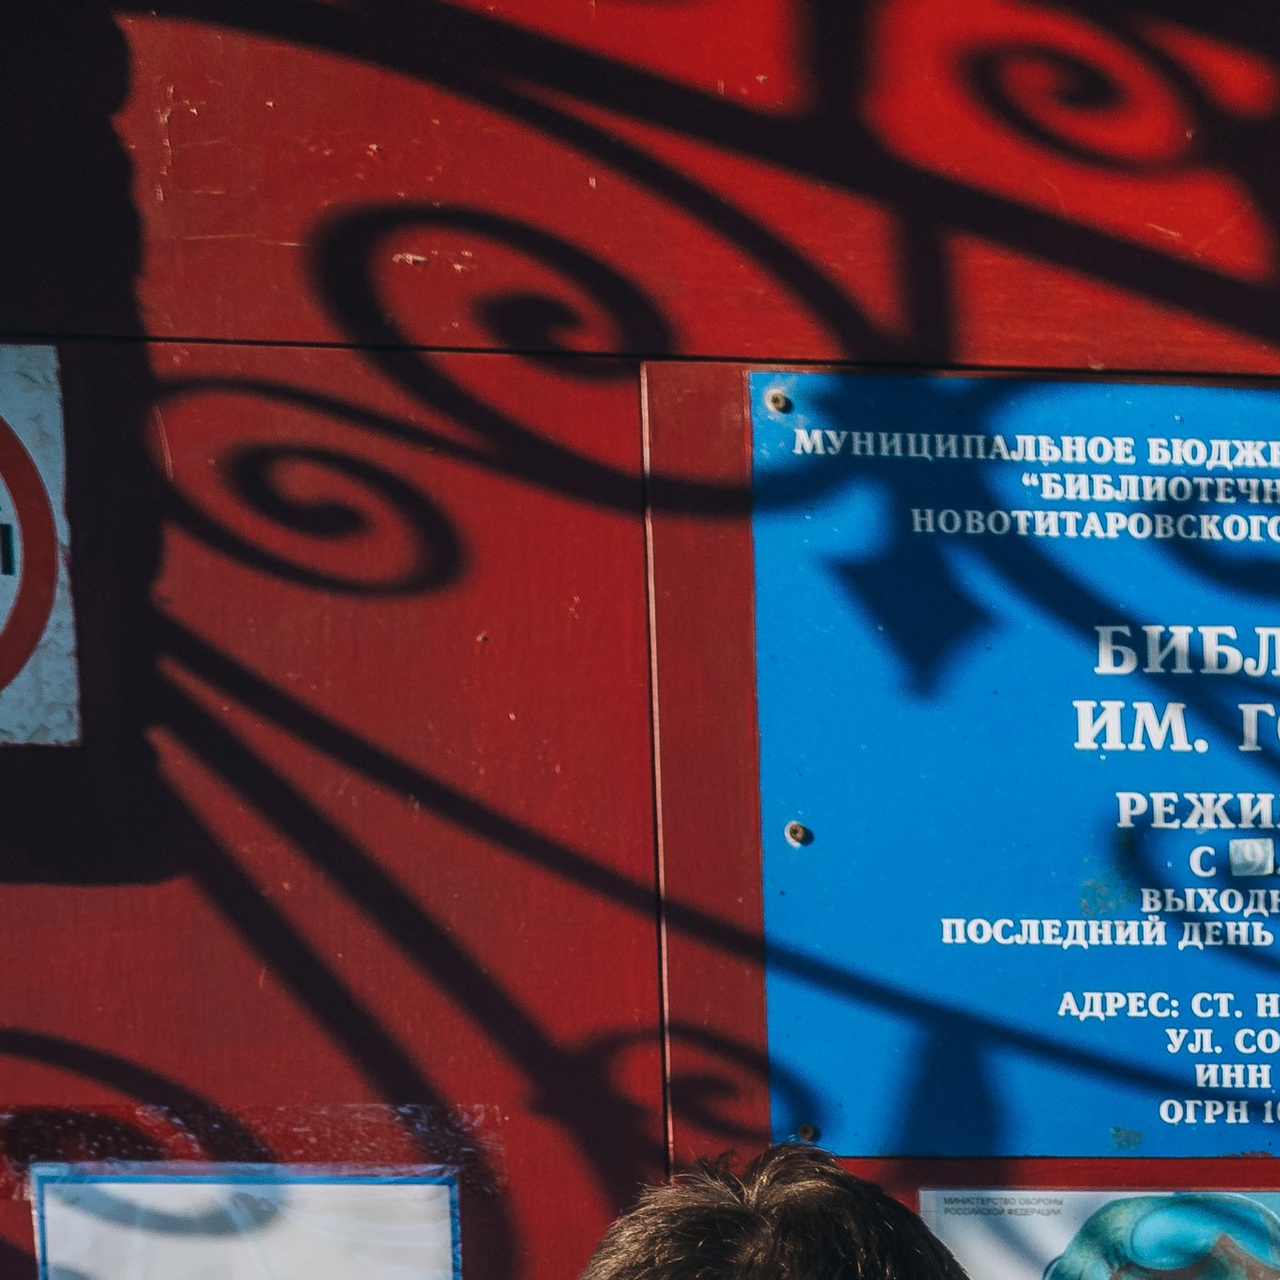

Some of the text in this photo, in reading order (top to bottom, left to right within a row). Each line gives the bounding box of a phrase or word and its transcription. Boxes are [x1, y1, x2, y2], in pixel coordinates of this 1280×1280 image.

[793, 429, 1135, 464] МУНИЦИПАЛЬНОЕ
[1073, 700, 1209, 755] ИМ.
[1189, 845, 1217, 877] С
[940, 915, 1168, 949] ПОСЛЕДНИЙ
[1178, 920, 1275, 949] ДЕНЬ
[1058, 991, 1180, 1021] АДРЕС:
[1191, 992, 1243, 1019] СТ.
[1166, 1029, 1222, 1055] УЛ.
[1195, 1064, 1272, 1089] ИНН
[1159, 1099, 1250, 1124] ОГРН
